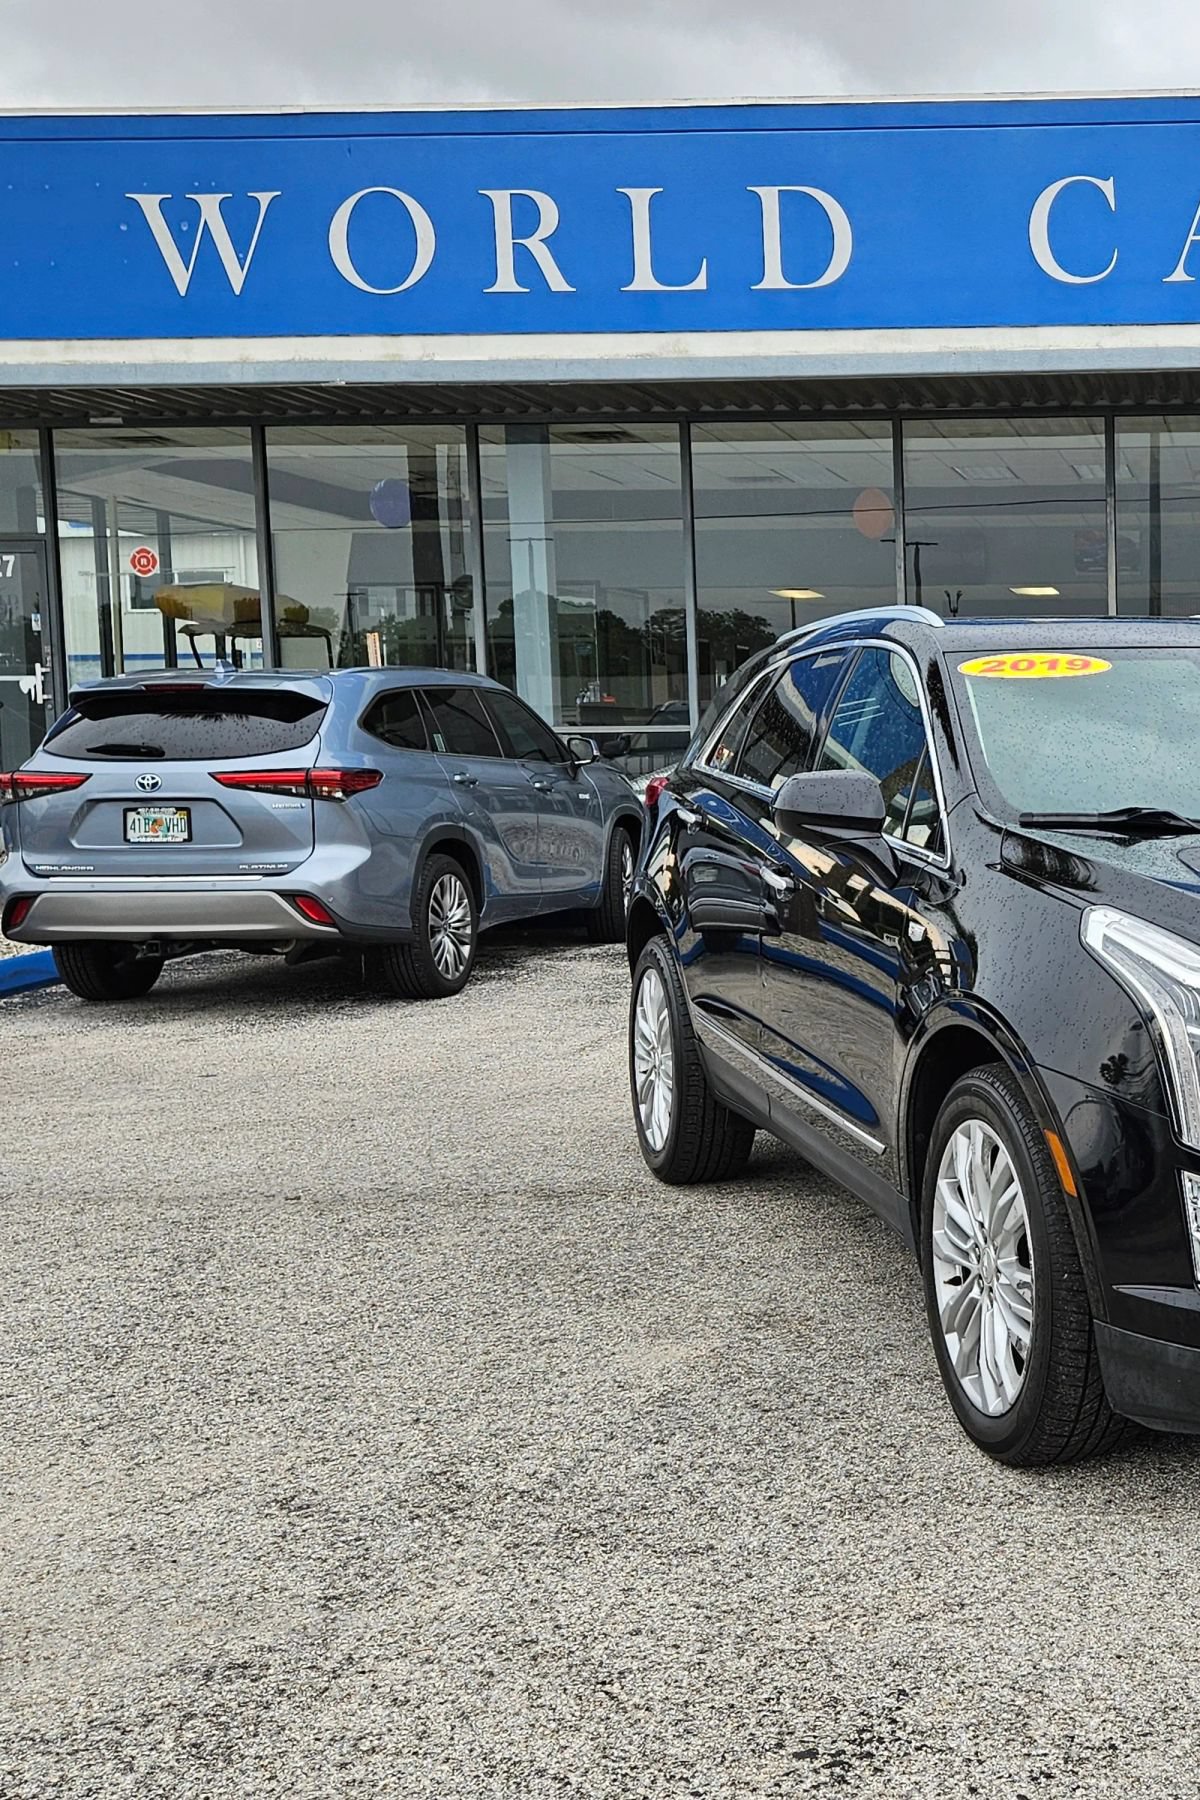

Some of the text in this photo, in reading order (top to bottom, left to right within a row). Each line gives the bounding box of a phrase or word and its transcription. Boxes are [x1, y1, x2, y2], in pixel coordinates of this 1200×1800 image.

[125, 186, 854, 297] WORLD
[0, 554, 16, 578] 7
[977, 658, 1093, 674] 2019
